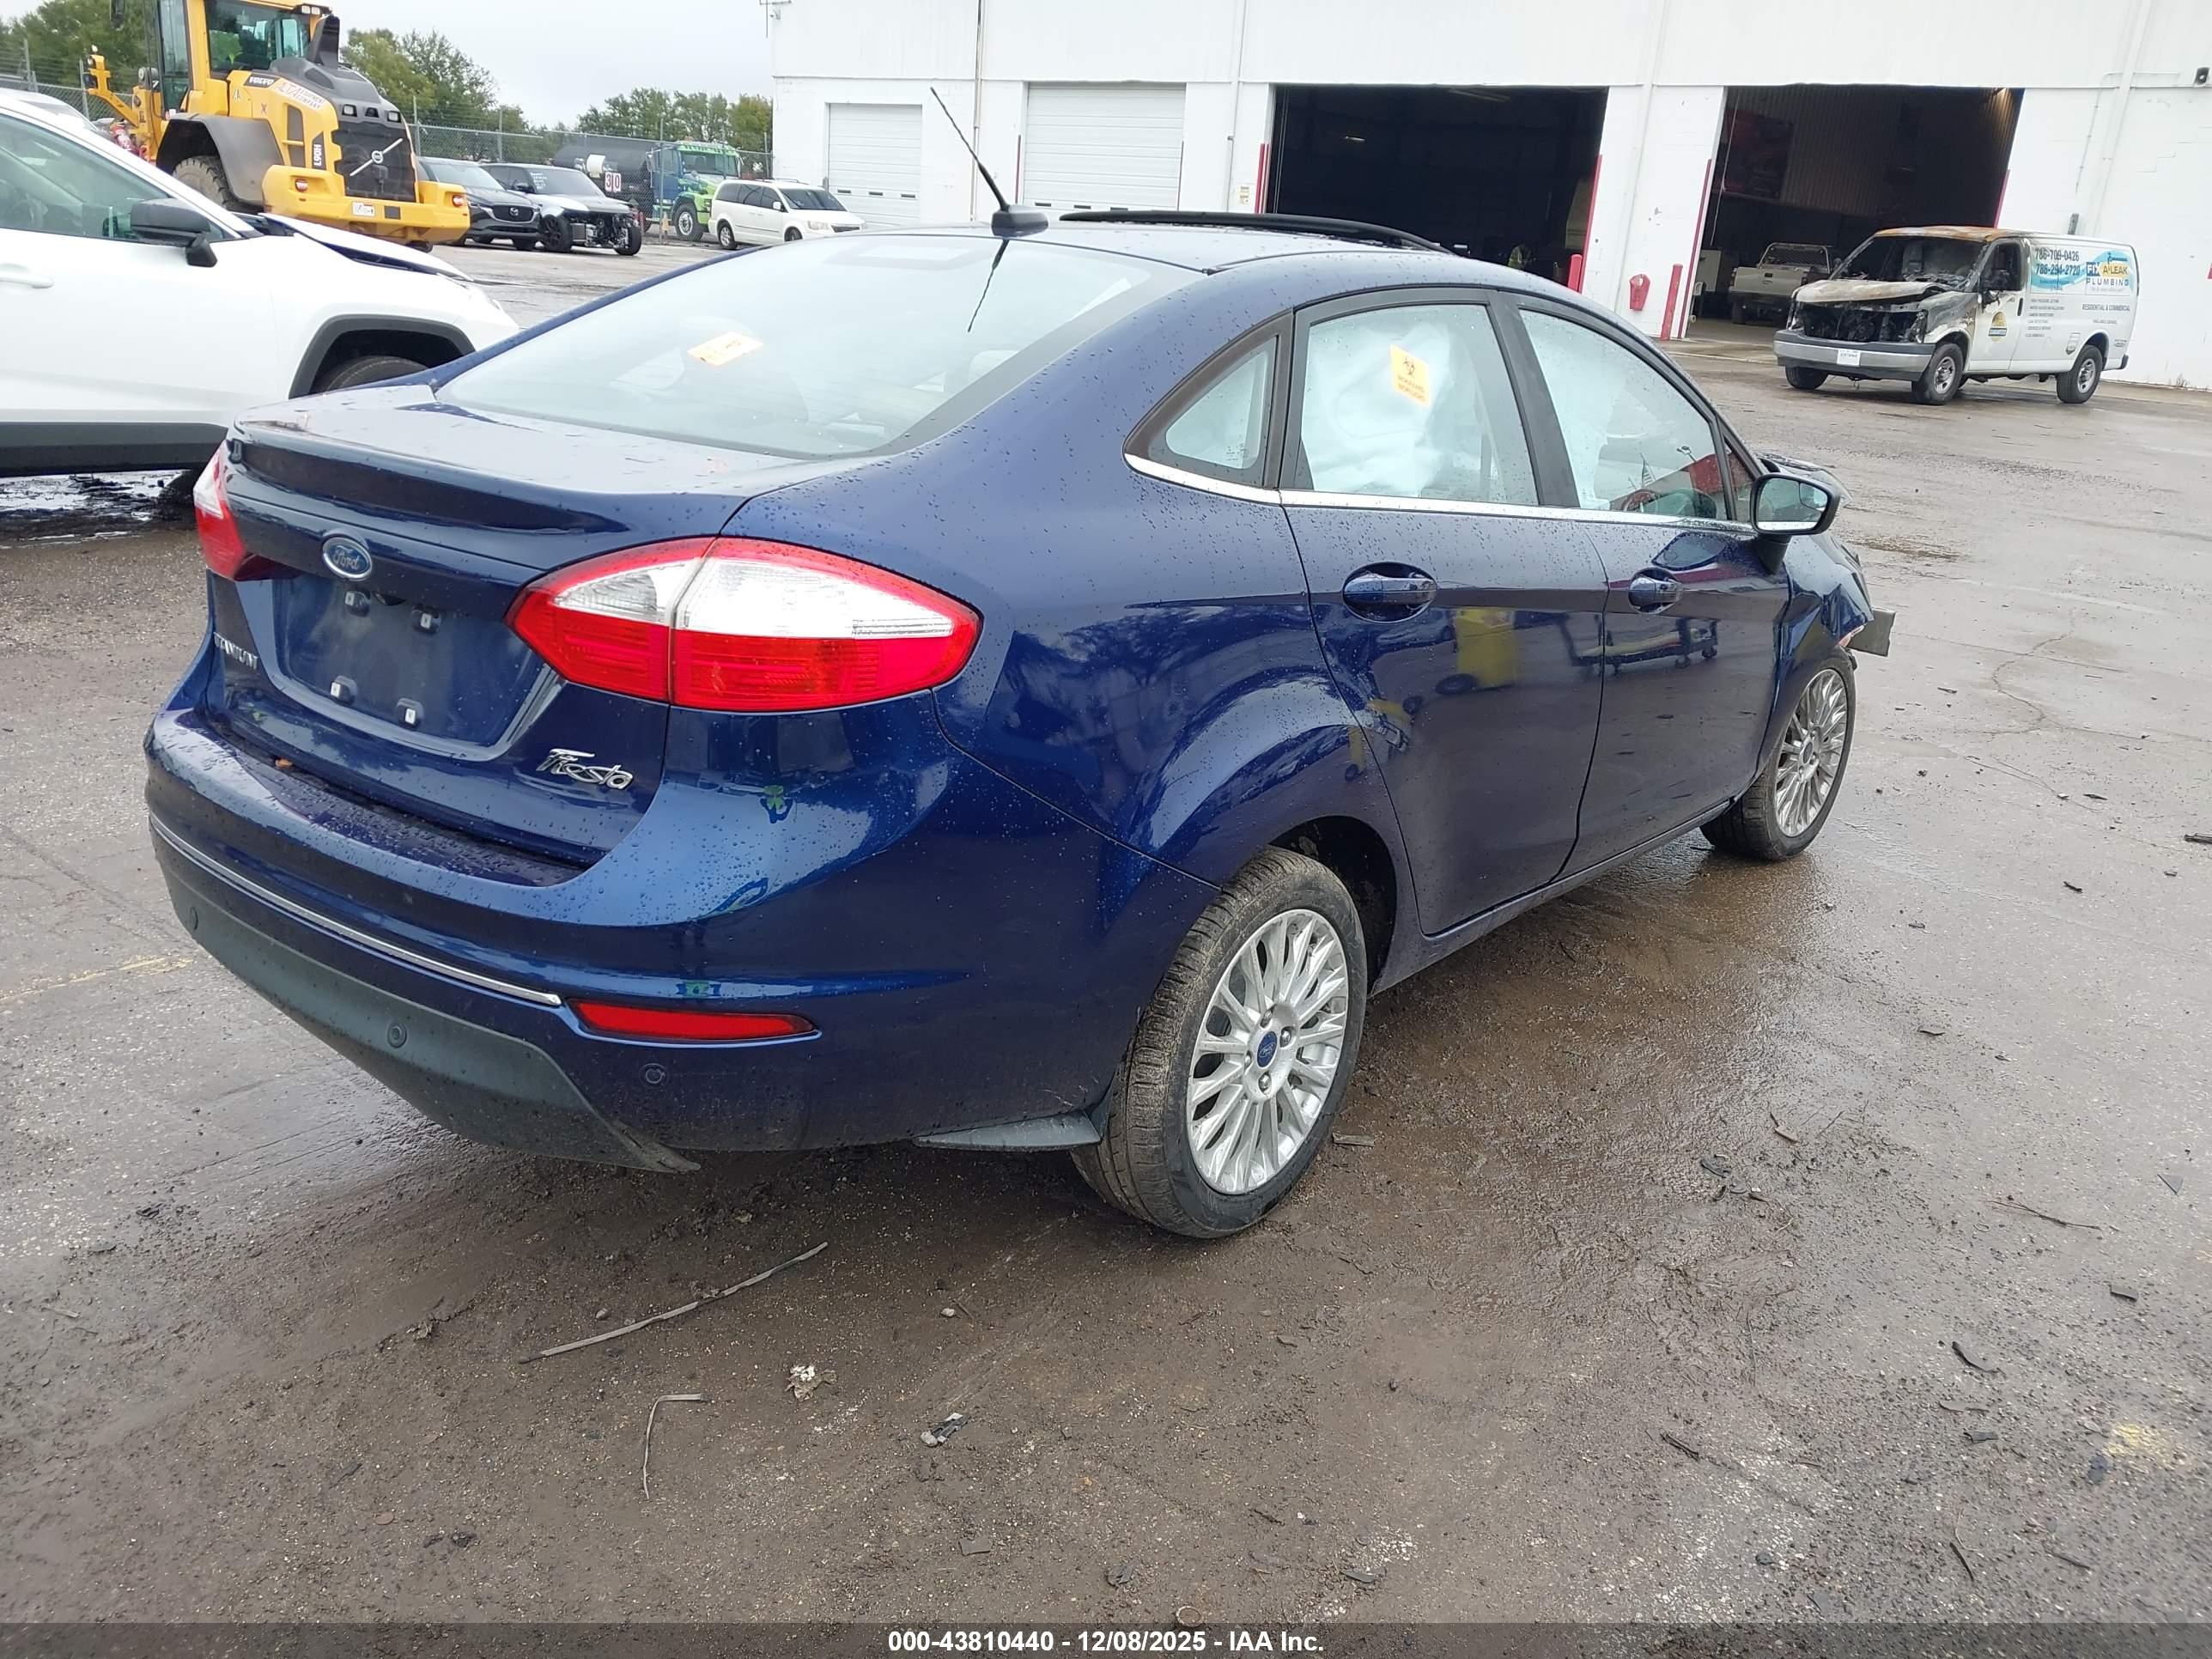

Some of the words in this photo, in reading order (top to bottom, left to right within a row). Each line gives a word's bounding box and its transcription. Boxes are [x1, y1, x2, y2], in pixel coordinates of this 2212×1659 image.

[313, 143, 322, 166] L90H
[2035, 247, 2080, 262] 786-709-0426
[2087, 264, 2101, 275] FIX
[332, 545, 360, 570] Ford
[535, 748, 634, 789] Fiesta
